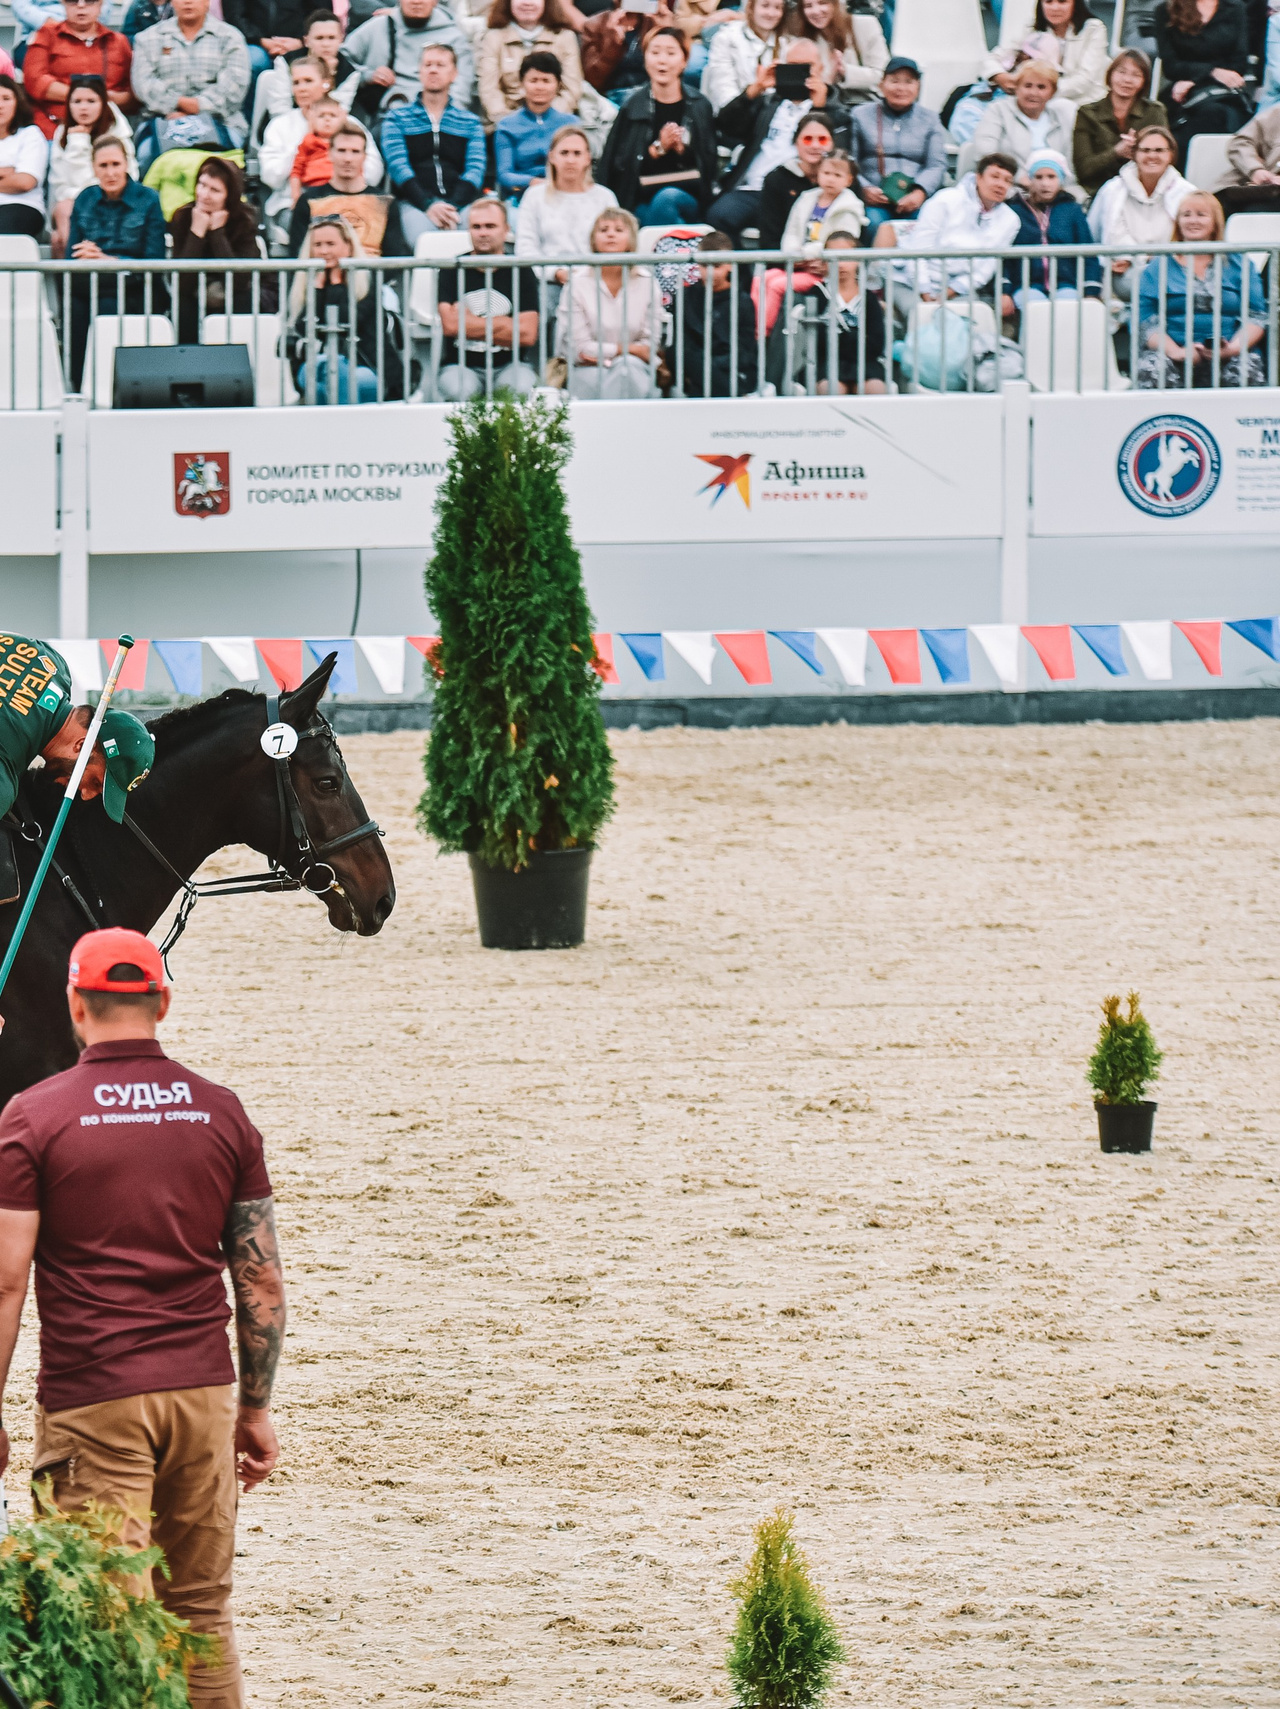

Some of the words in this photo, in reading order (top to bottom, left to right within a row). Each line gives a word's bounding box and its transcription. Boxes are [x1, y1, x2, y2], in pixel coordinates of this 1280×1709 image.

[247, 464, 330, 480] КОМИТЕТ
[336, 463, 361, 479] ПО
[366, 461, 446, 478] ТУРИЗМУ
[763, 460, 865, 486] Афиша
[247, 487, 320, 506] ГОРОДА
[323, 486, 402, 502] МОСКВЫ
[762, 491, 819, 501] ПРОЕКТ
[9, 667, 53, 716] TEAM
[271, 734, 284, 754] 7
[94, 1081, 193, 1110] СУДЬЯ
[80, 1114, 100, 1126] по
[102, 1112, 162, 1125] конному
[164, 1110, 211, 1125] спорту
